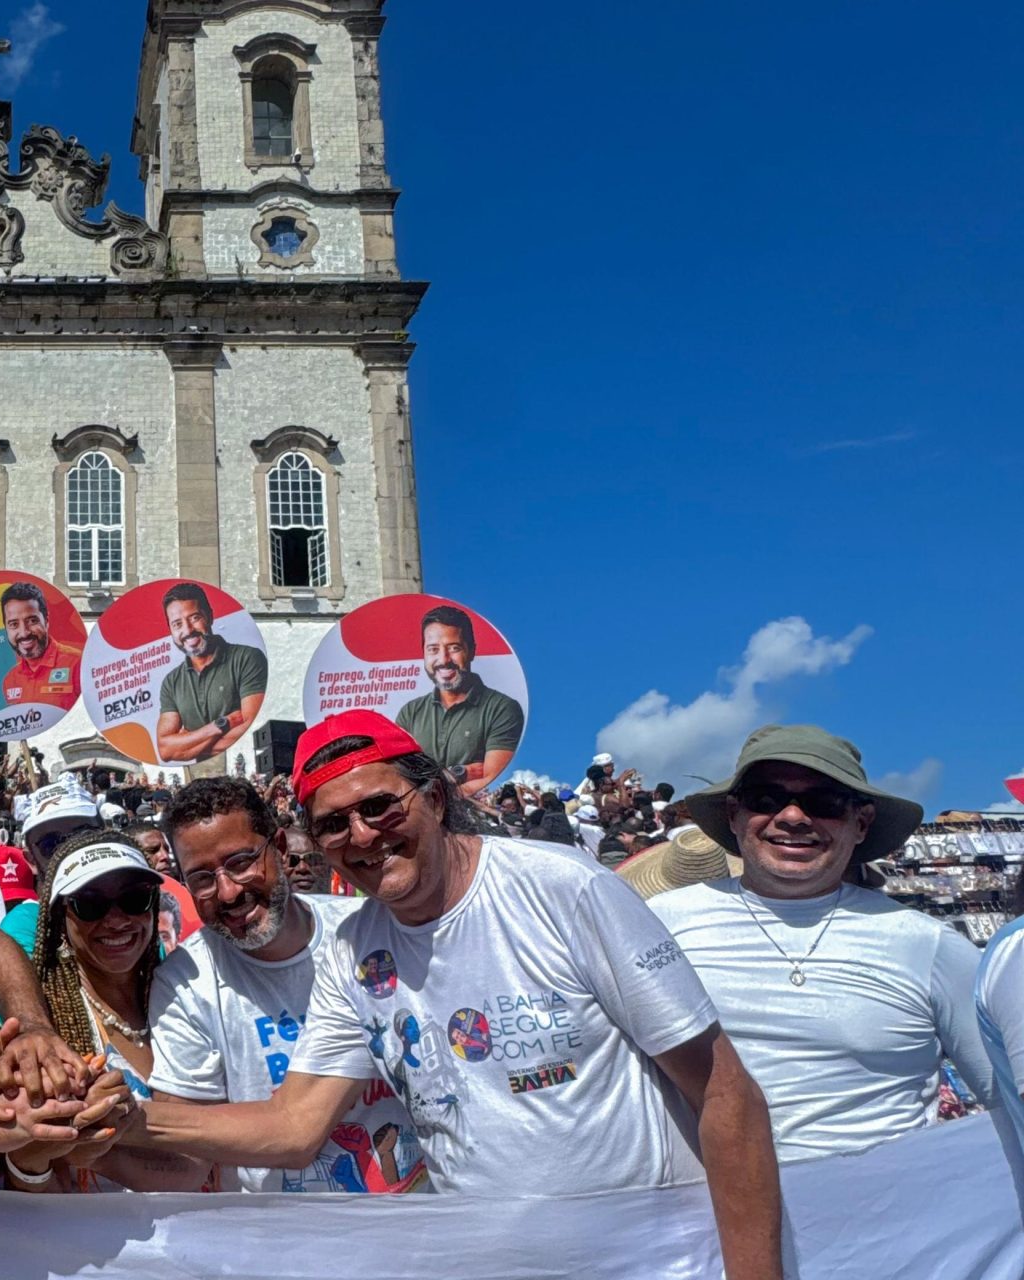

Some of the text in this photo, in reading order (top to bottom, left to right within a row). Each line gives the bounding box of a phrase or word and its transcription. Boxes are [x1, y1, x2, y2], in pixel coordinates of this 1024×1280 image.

[91, 642, 171, 678] Emprego, dignidade
[94, 655, 170, 688] e desenvolvimento
[318, 665, 420, 685] Emprego, dignidade
[98, 672, 151, 702] para a Bahia!
[319, 679, 417, 696] e desenvolvimento
[320, 693, 388, 712] para a Bahia!
[105, 705, 140, 723] BACELAR
[639, 940, 676, 964] LAVAGE
[483, 999, 493, 1014] A
[489, 1009, 568, 1038] SEGUE
[491, 1039, 545, 1062] COM
[506, 1066, 536, 1076] GOVERNO
[548, 1058, 573, 1068] ESTADO
